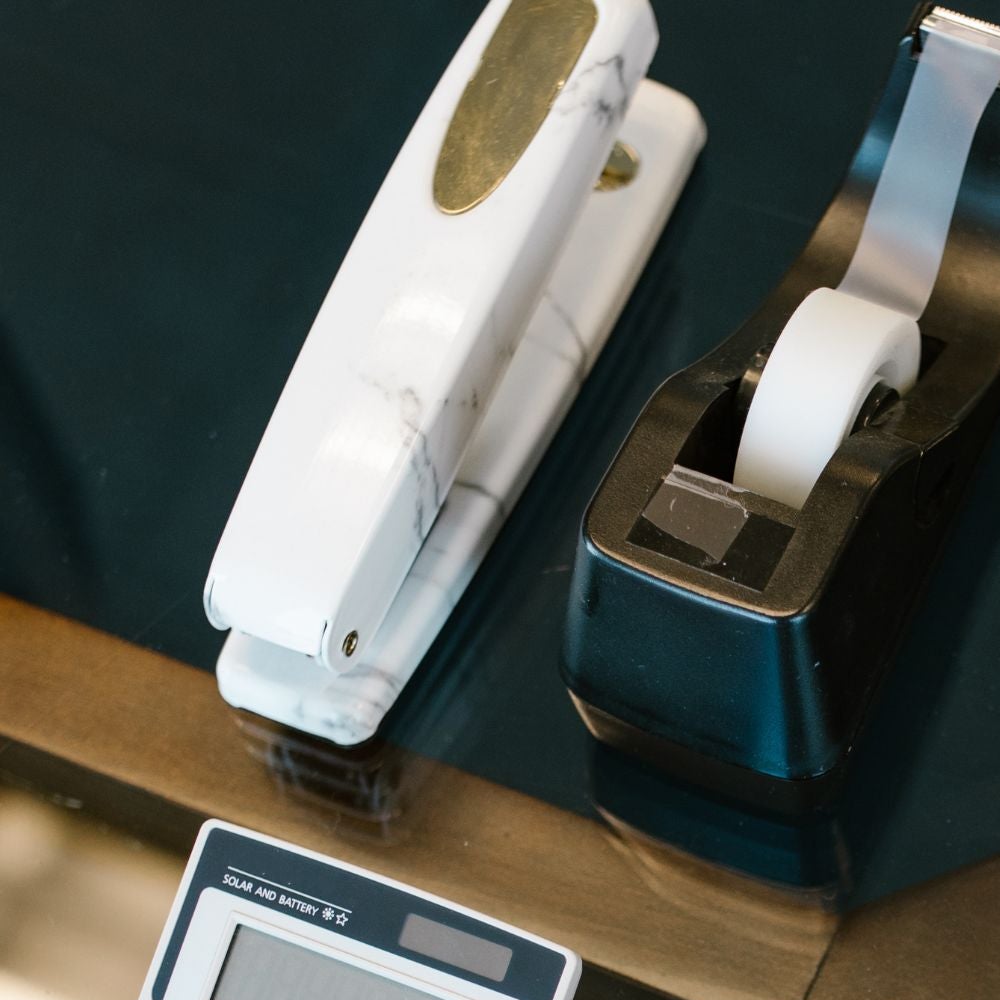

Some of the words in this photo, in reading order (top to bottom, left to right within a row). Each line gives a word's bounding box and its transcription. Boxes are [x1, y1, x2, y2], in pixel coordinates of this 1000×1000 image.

[222, 874, 253, 893] SOLAR
[255, 886, 277, 901] AND
[278, 894, 320, 916] BATTERY
